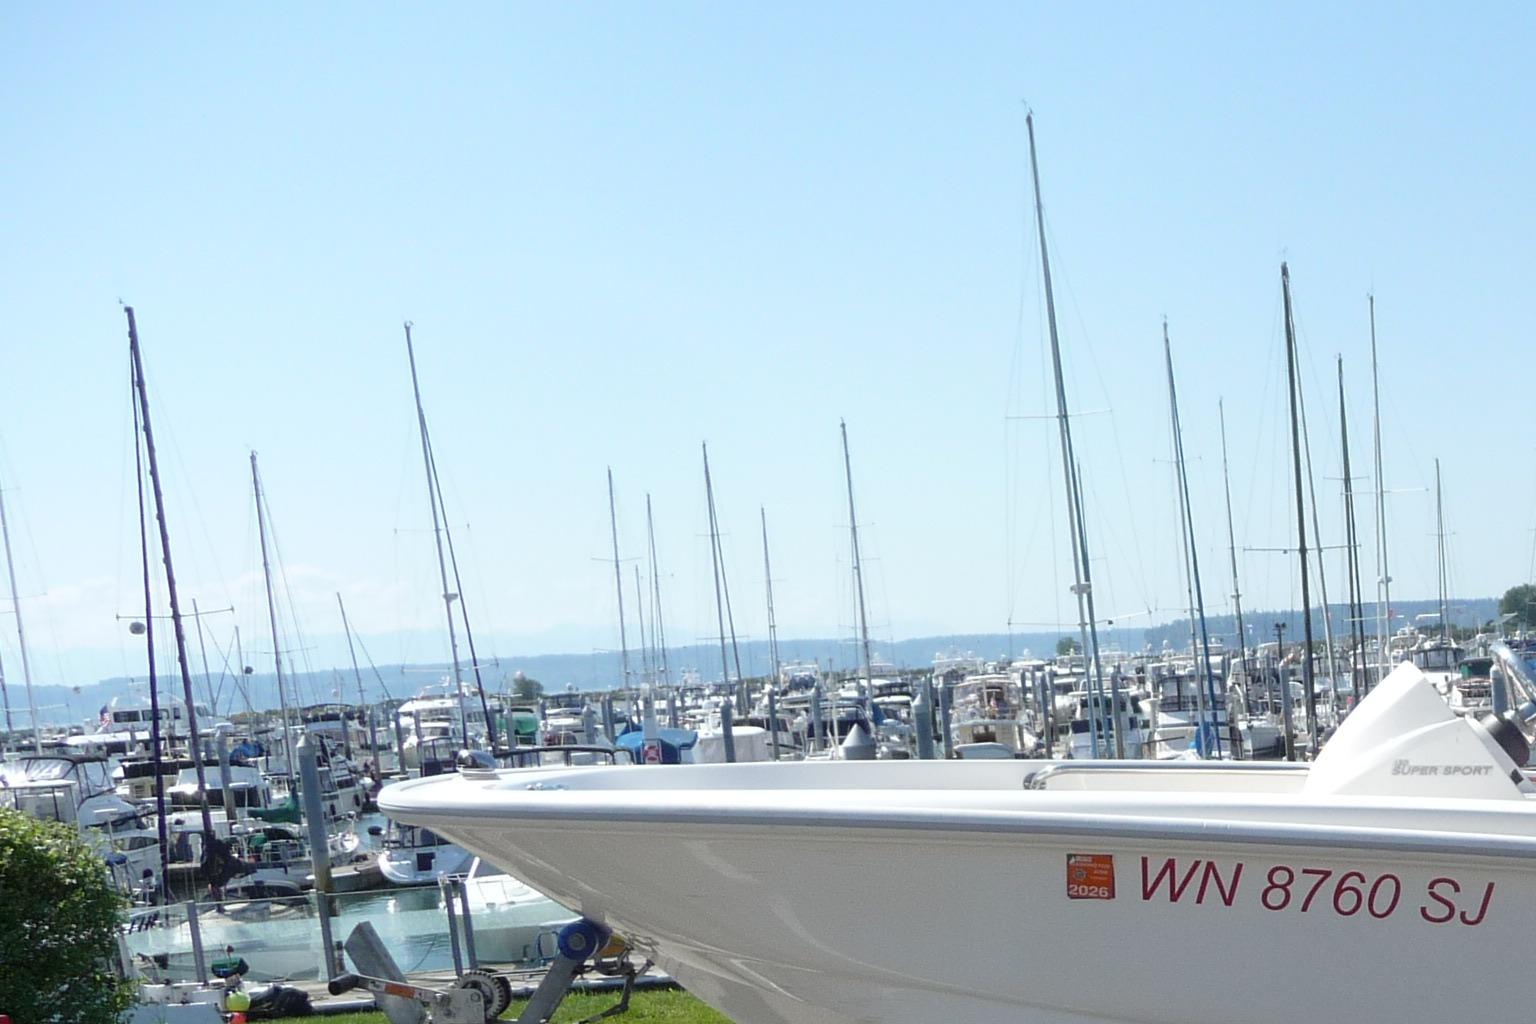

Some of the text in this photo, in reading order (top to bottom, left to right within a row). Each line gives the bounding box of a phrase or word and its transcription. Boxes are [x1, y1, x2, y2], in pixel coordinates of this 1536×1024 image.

[1392, 765, 1493, 776] SUPER SPORT
[1069, 885, 1108, 897] 2026
[1141, 856, 1495, 926] WN 8760 SJ
